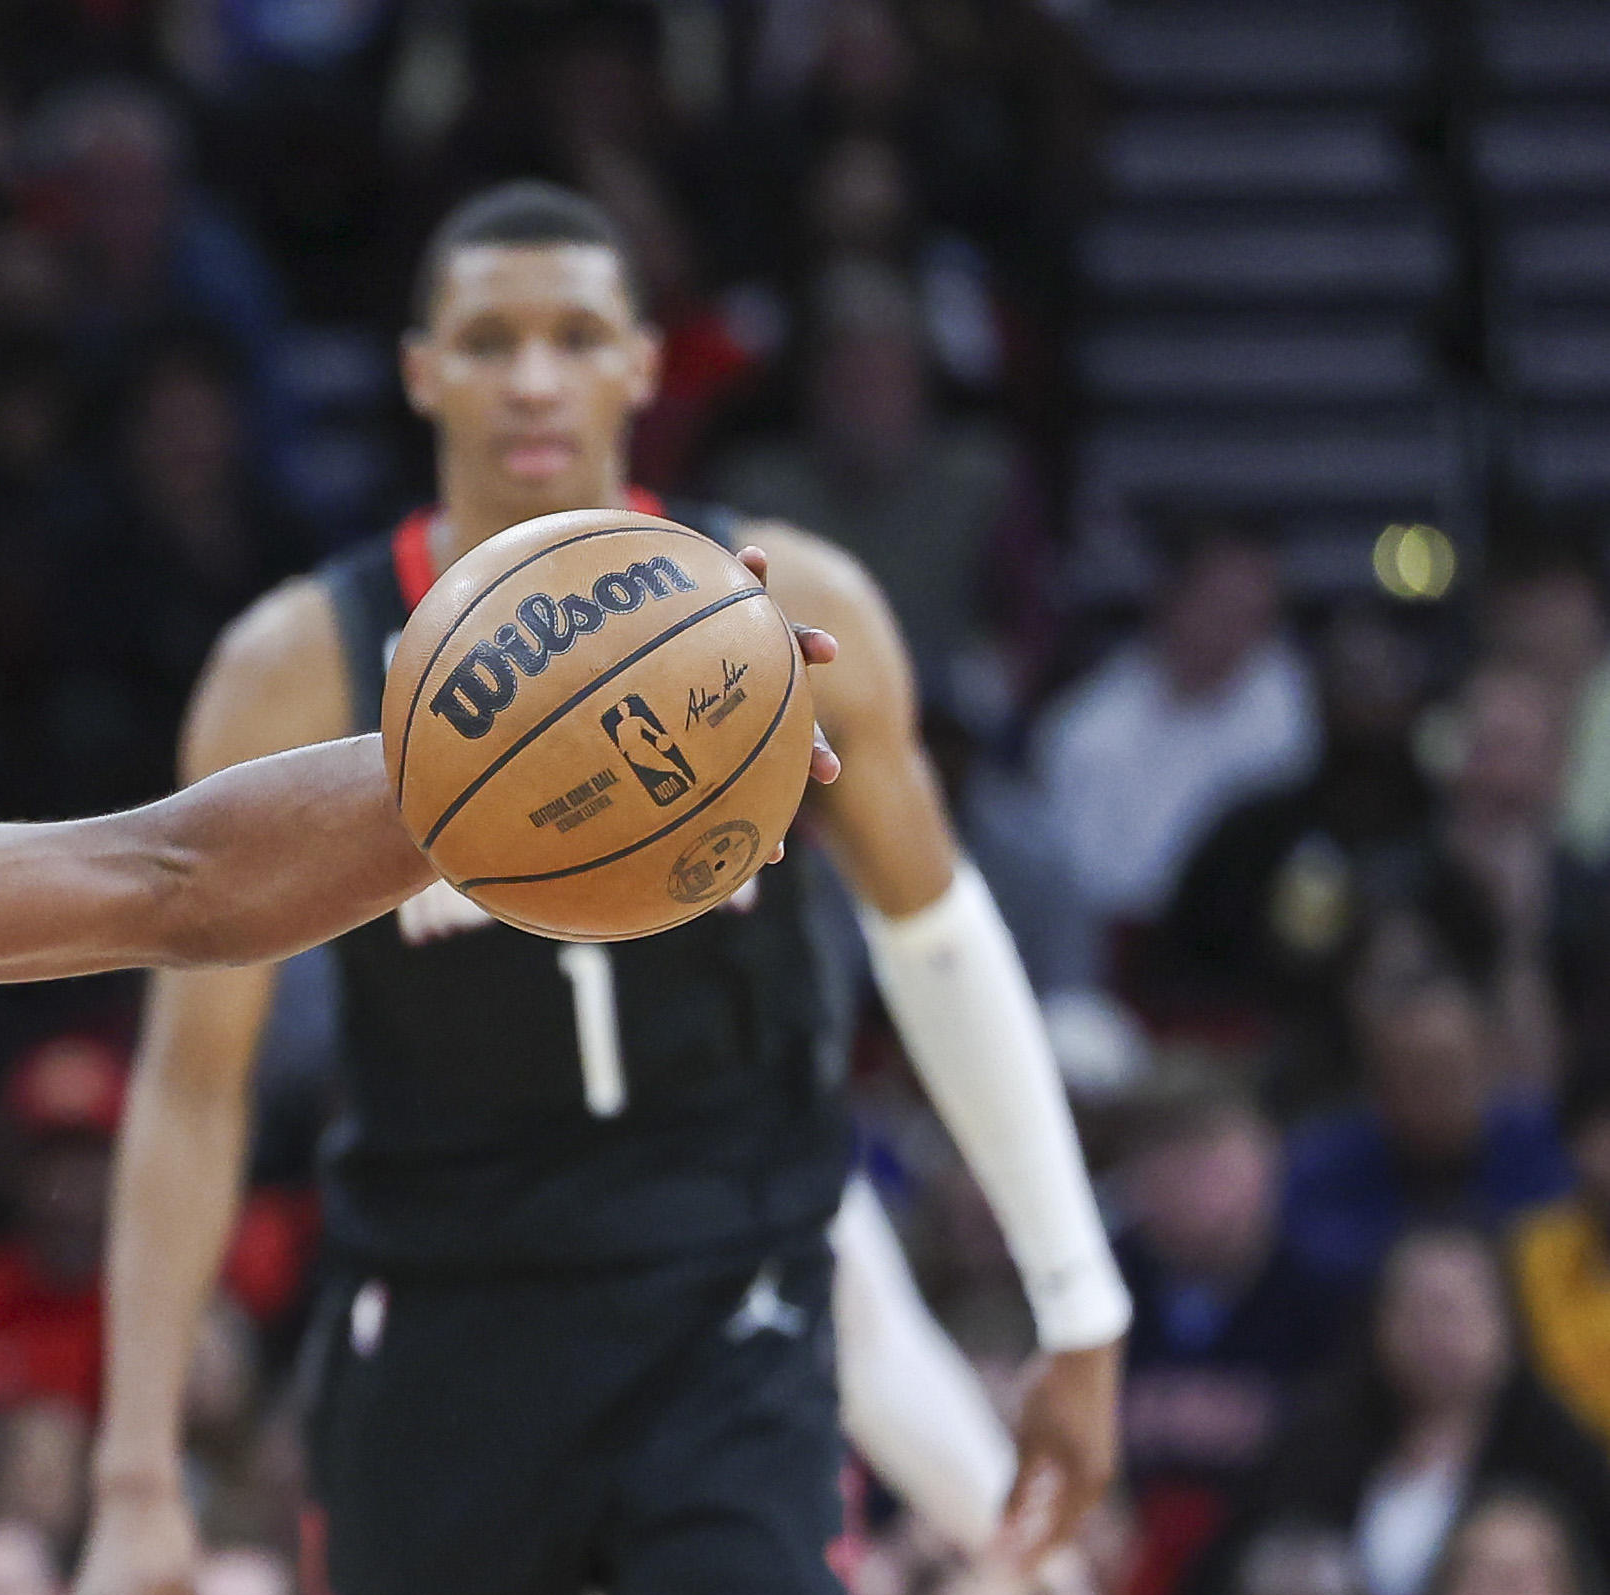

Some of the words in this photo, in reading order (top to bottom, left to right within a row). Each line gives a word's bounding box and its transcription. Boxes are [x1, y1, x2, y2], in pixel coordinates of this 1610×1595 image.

[429, 555, 698, 739] Wilson
[654, 776, 681, 800] NBA
[558, 942, 627, 1118] 1
